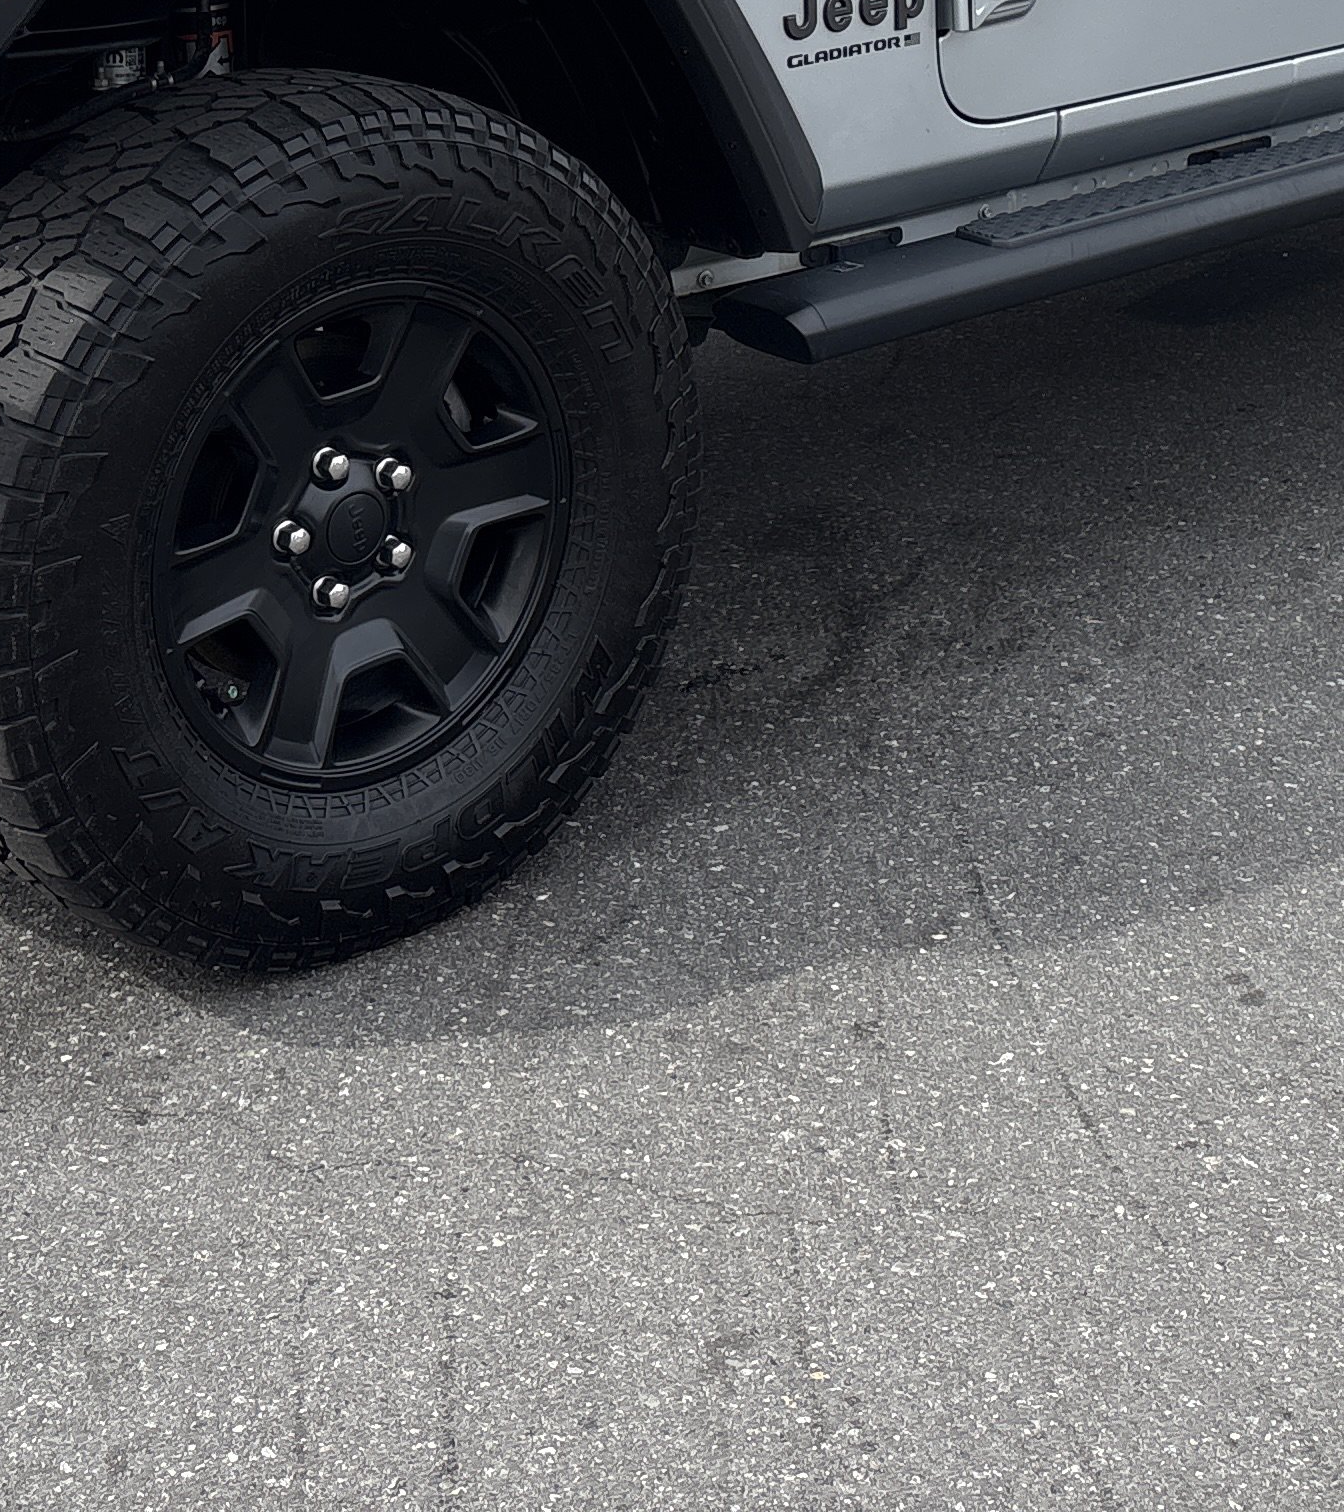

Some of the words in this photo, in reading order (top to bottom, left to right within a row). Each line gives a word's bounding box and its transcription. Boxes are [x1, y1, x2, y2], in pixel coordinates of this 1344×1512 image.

[786, 35, 901, 69] GLADIATOR
[317, 192, 635, 364] FALKEN
[347, 503, 368, 551] Jeep
[222, 633, 616, 893] WILDPEAK
